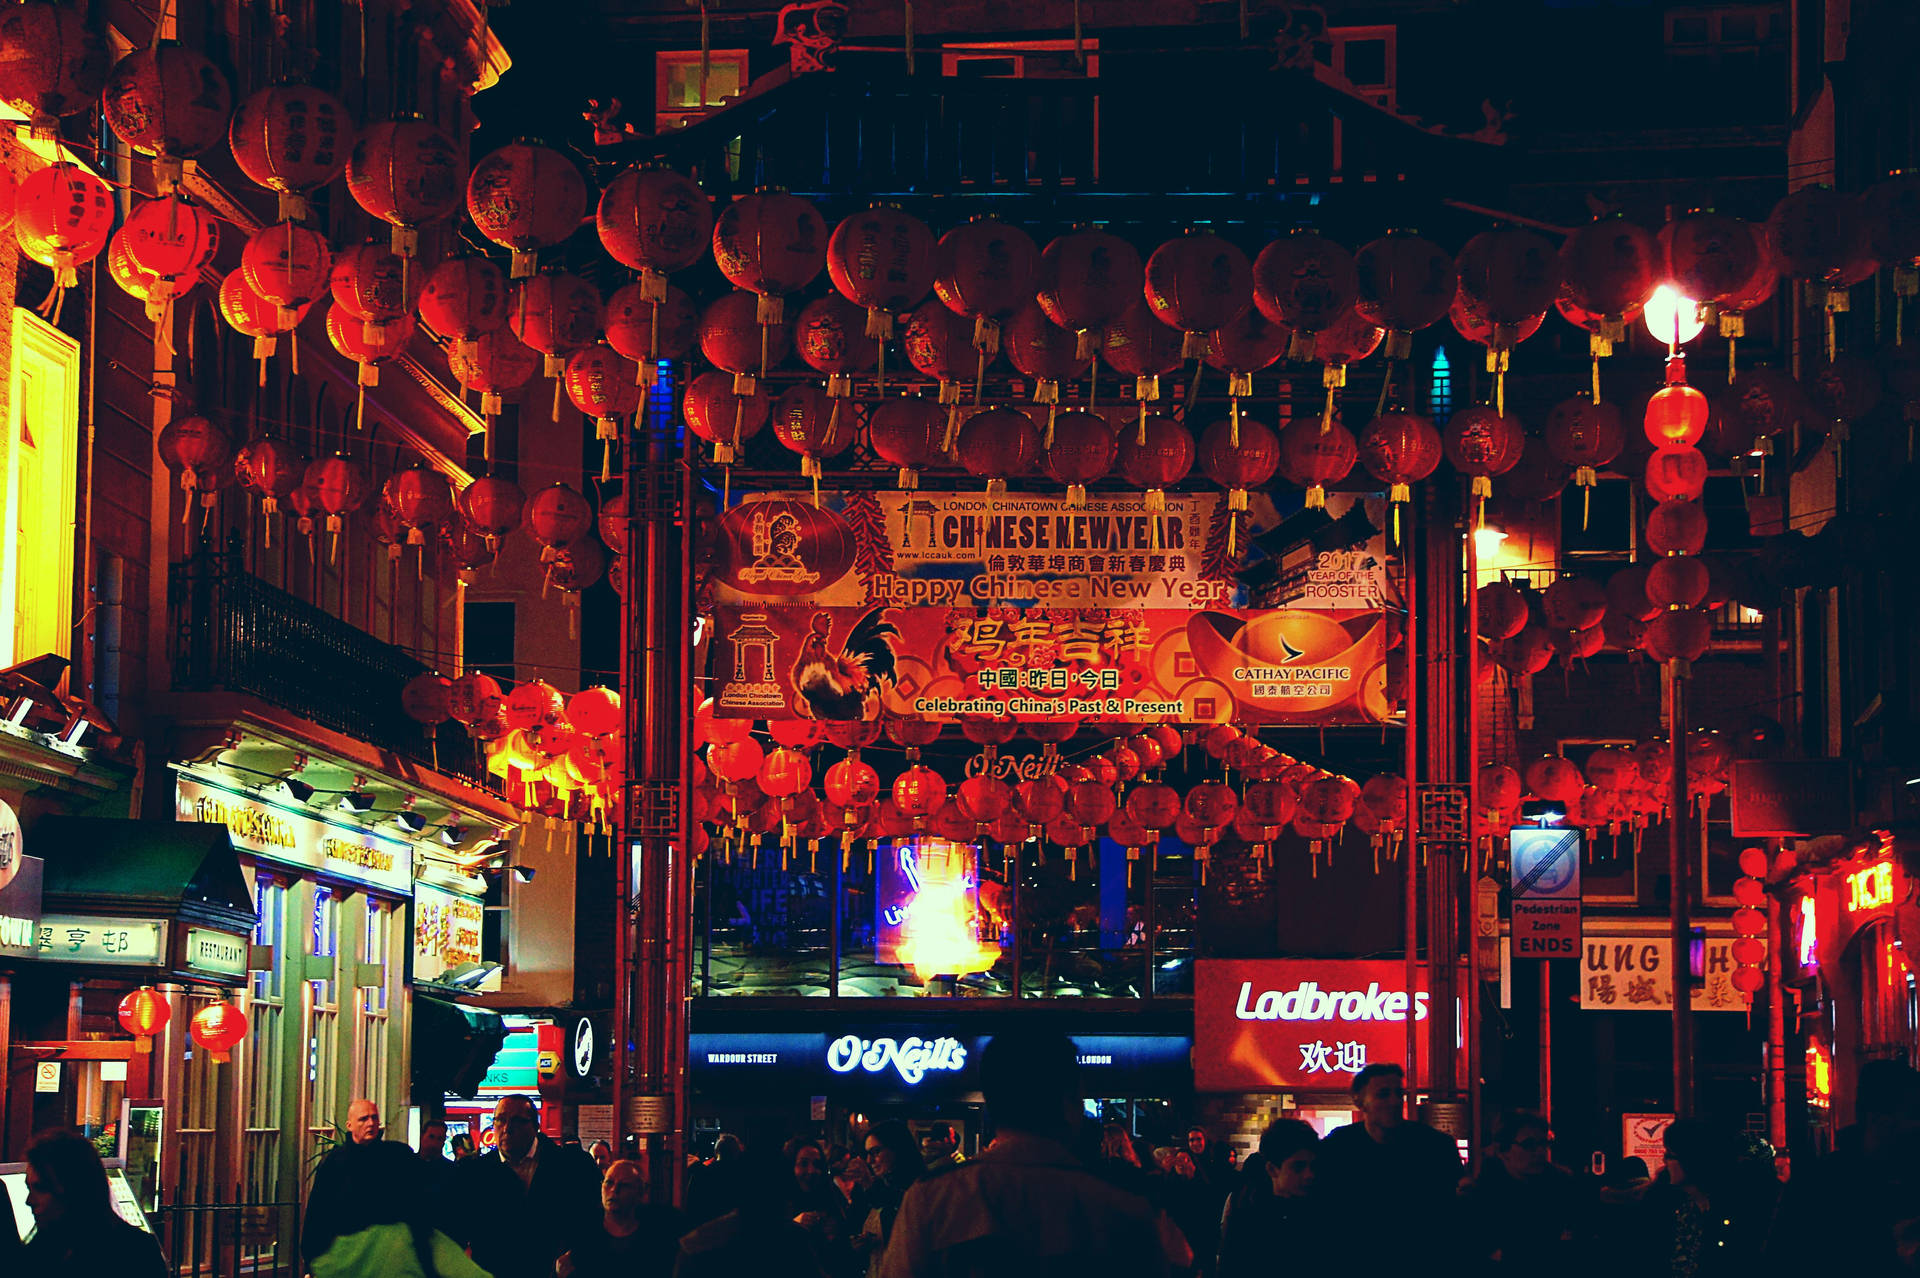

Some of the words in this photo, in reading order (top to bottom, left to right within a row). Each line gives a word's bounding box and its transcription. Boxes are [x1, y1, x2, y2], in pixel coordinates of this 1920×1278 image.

[943, 501, 987, 511] LONDON
[992, 501, 1056, 512] CHINATOWN
[1110, 502, 1184, 512] ASSOCION
[942, 515, 1048, 550] CHINESE
[1055, 516, 1109, 550] NEW
[1112, 516, 1184, 550] YEAR
[896, 551, 975, 560] www.lccauk.com
[1319, 553, 1363, 569] 2017
[988, 555, 1185, 572] 倫敦華埠商會新春慶典
[1310, 572, 1334, 580] YEAR
[1338, 572, 1352, 580] OF
[1355, 571, 1373, 580] THE
[875, 575, 961, 603] Happy
[971, 573, 1079, 599] Chinese
[1091, 578, 1150, 598] New
[1161, 578, 1223, 598] Year
[1306, 586, 1376, 598] ROOSTER
[1235, 669, 1291, 680] CATHAY
[1295, 669, 1349, 680] PACIFIC
[1254, 685, 1331, 697] 國泰航空公司
[915, 699, 1004, 714] Celebrating
[1009, 699, 1064, 713] China's
[1069, 700, 1102, 713] Past
[1106, 700, 1120, 712] &
[1125, 700, 1183, 713] Present
[1515, 904, 1576, 914] Pedestrian
[1533, 921, 1560, 931] Zone
[200, 941, 243, 963] RESTAURANT
[1520, 938, 1572, 952] ENDS
[1586, 944, 1659, 972] UNG
[1236, 981, 1430, 1021] Ladbrokes
[707, 1054, 745, 1063] WARDOUR
[746, 1054, 777, 1063] STREET
[827, 1035, 967, 1084] O'Neill's
[1299, 1040, 1367, 1074] 欢迎
[485, 1072, 509, 1083] NKS
